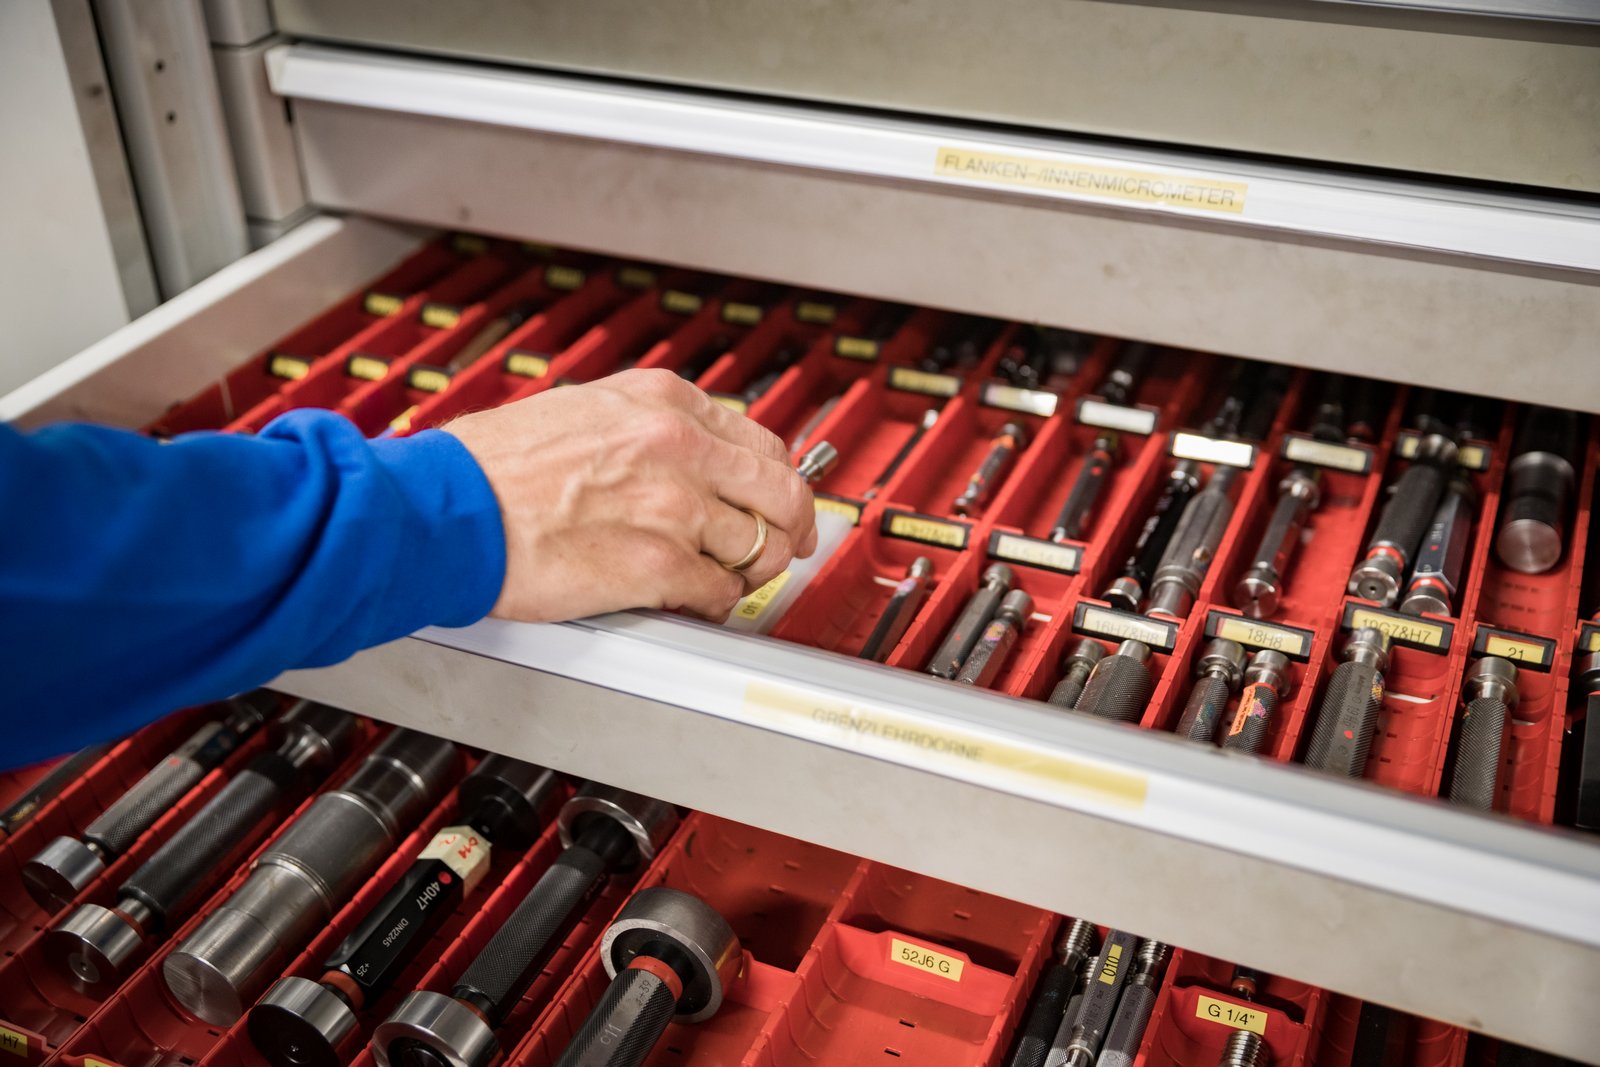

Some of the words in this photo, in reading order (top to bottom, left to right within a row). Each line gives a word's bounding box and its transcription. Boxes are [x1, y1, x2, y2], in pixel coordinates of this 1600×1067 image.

[1094, 619, 1160, 643] 16H7&H8
[1247, 628, 1283, 649] 18H8
[1508, 646, 1525, 661] 21
[416, 881, 441, 911] 40H7
[382, 917, 409, 948] DIN2245
[356, 962, 370, 977] +25
[901, 947, 935, 969] 52J6
[938, 960, 950, 973] G
[1101, 955, 1120, 977] 010
[1208, 1003, 1221, 1018] G
[1227, 1009, 1255, 1025] 1/4"
